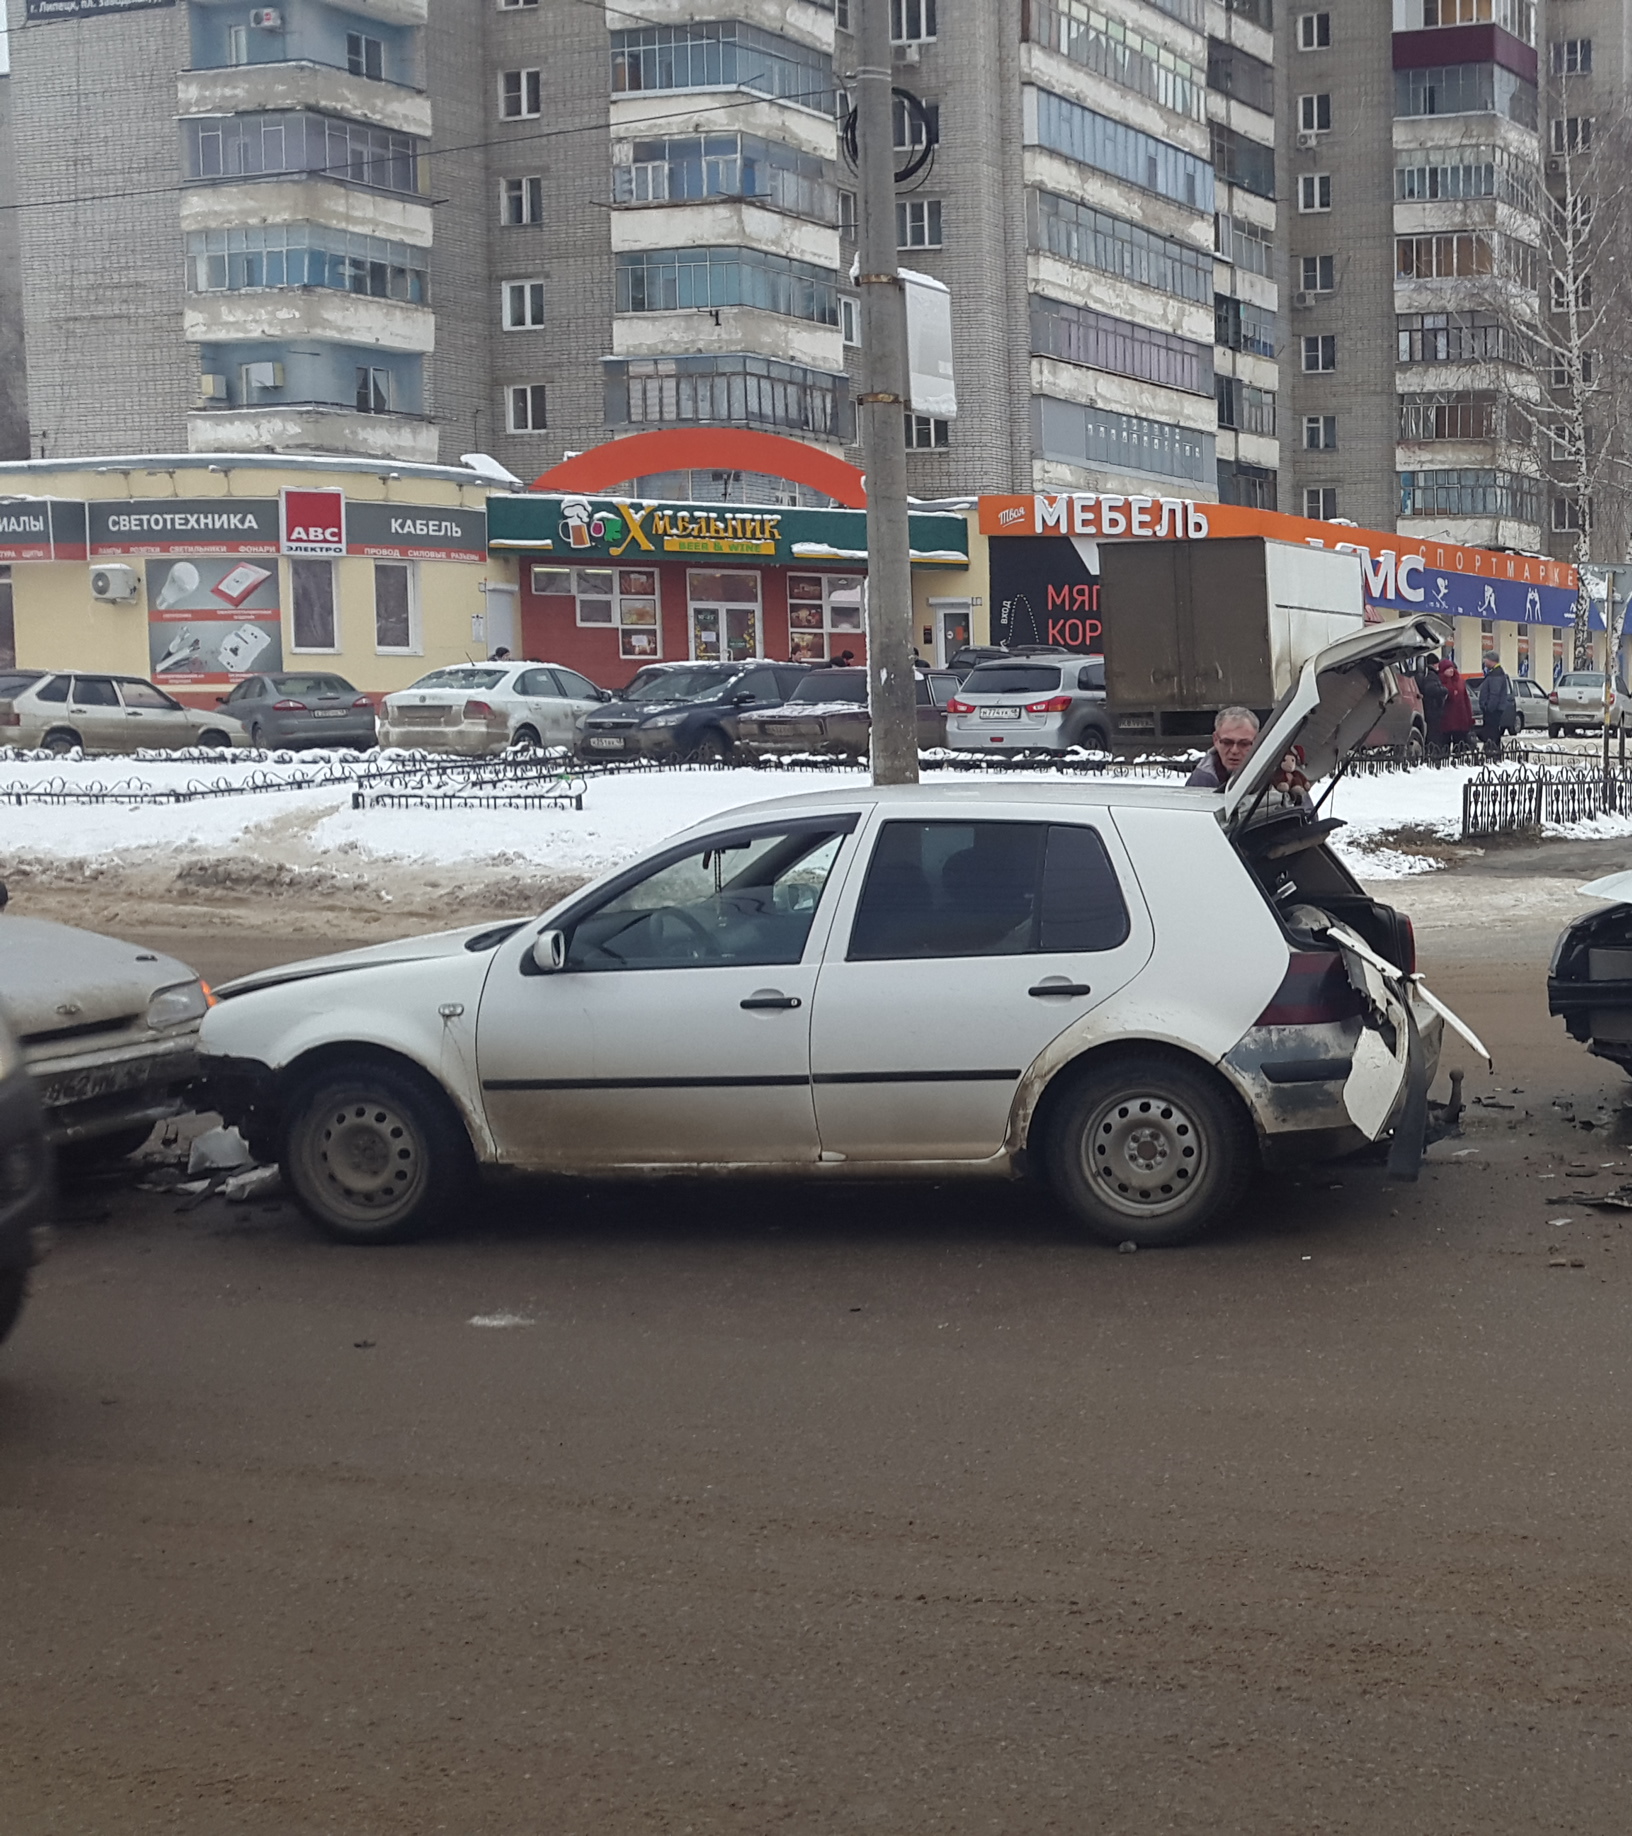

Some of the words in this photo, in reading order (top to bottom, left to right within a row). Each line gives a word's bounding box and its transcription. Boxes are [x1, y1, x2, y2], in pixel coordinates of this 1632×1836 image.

[108, 513, 259, 531] СВЕТОТЕХНИКА
[998, 506, 1026, 526] Твоя
[1034, 494, 1209, 539] МЕБЕЛЬ
[290, 526, 339, 541] АВС
[391, 518, 462, 537] КАБЕЛЬ
[169, 545, 227, 554] СВЕТИЛЬНИКИ
[238, 545, 276, 554] ФОНАРИ
[286, 545, 343, 554] ЭЛЕКТРО
[364, 547, 400, 557] ПРОВОД
[408, 549, 447, 559] СИЛОВЫЕ
[678, 541, 709, 551] BEER
[713, 541, 723, 551] &
[729, 542, 762, 552] WINE
[1001, 600, 1012, 624] ВХОД
[1048, 618, 1102, 646] КОР
